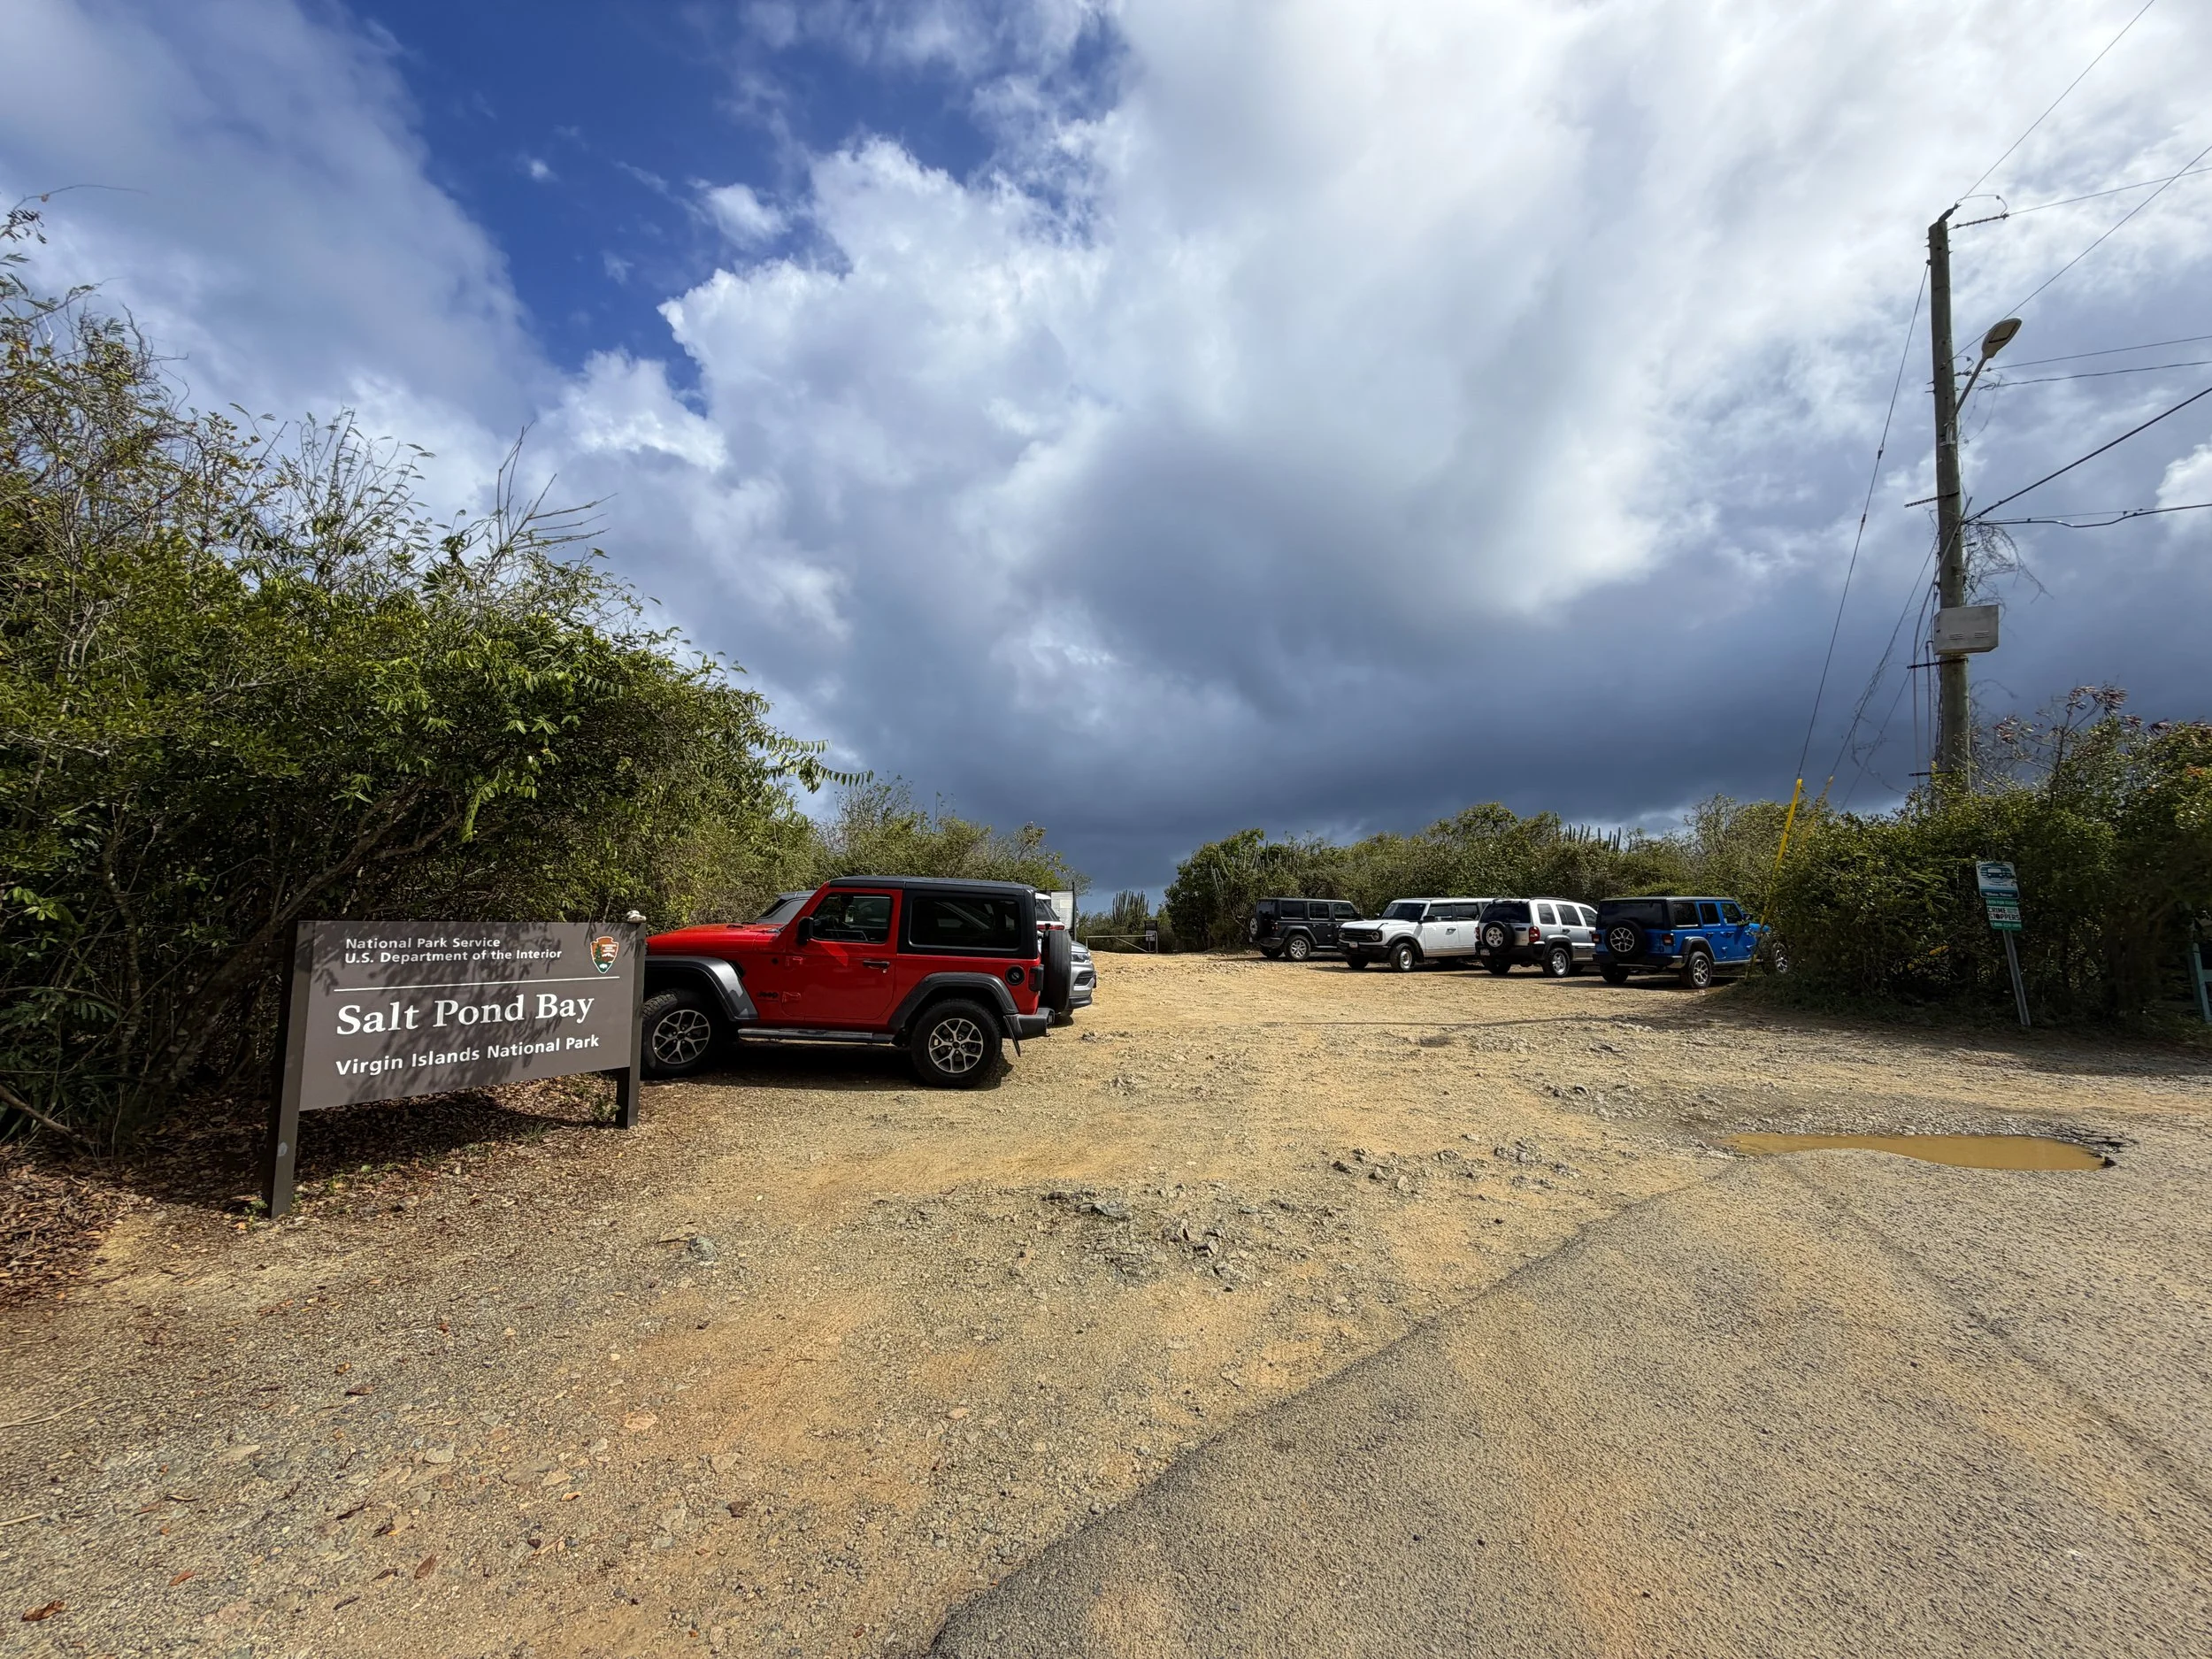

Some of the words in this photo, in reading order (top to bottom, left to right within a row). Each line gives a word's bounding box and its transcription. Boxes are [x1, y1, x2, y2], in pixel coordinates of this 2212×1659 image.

[345, 953, 374, 964] U.S.
[380, 951, 466, 964] Department
[472, 950, 486, 961] of
[491, 949, 512, 960] the
[517, 949, 563, 959] Interior
[346, 938, 412, 949] National
[417, 938, 448, 948] Park
[452, 937, 501, 948] Service
[336, 1001, 420, 1036] Salt
[433, 995, 526, 1028] Pond
[535, 993, 595, 1024] Bay
[335, 1056, 403, 1077] Virgin
[411, 1047, 480, 1067] Islands
[487, 1038, 561, 1059] National
[565, 1034, 600, 1048] Park
